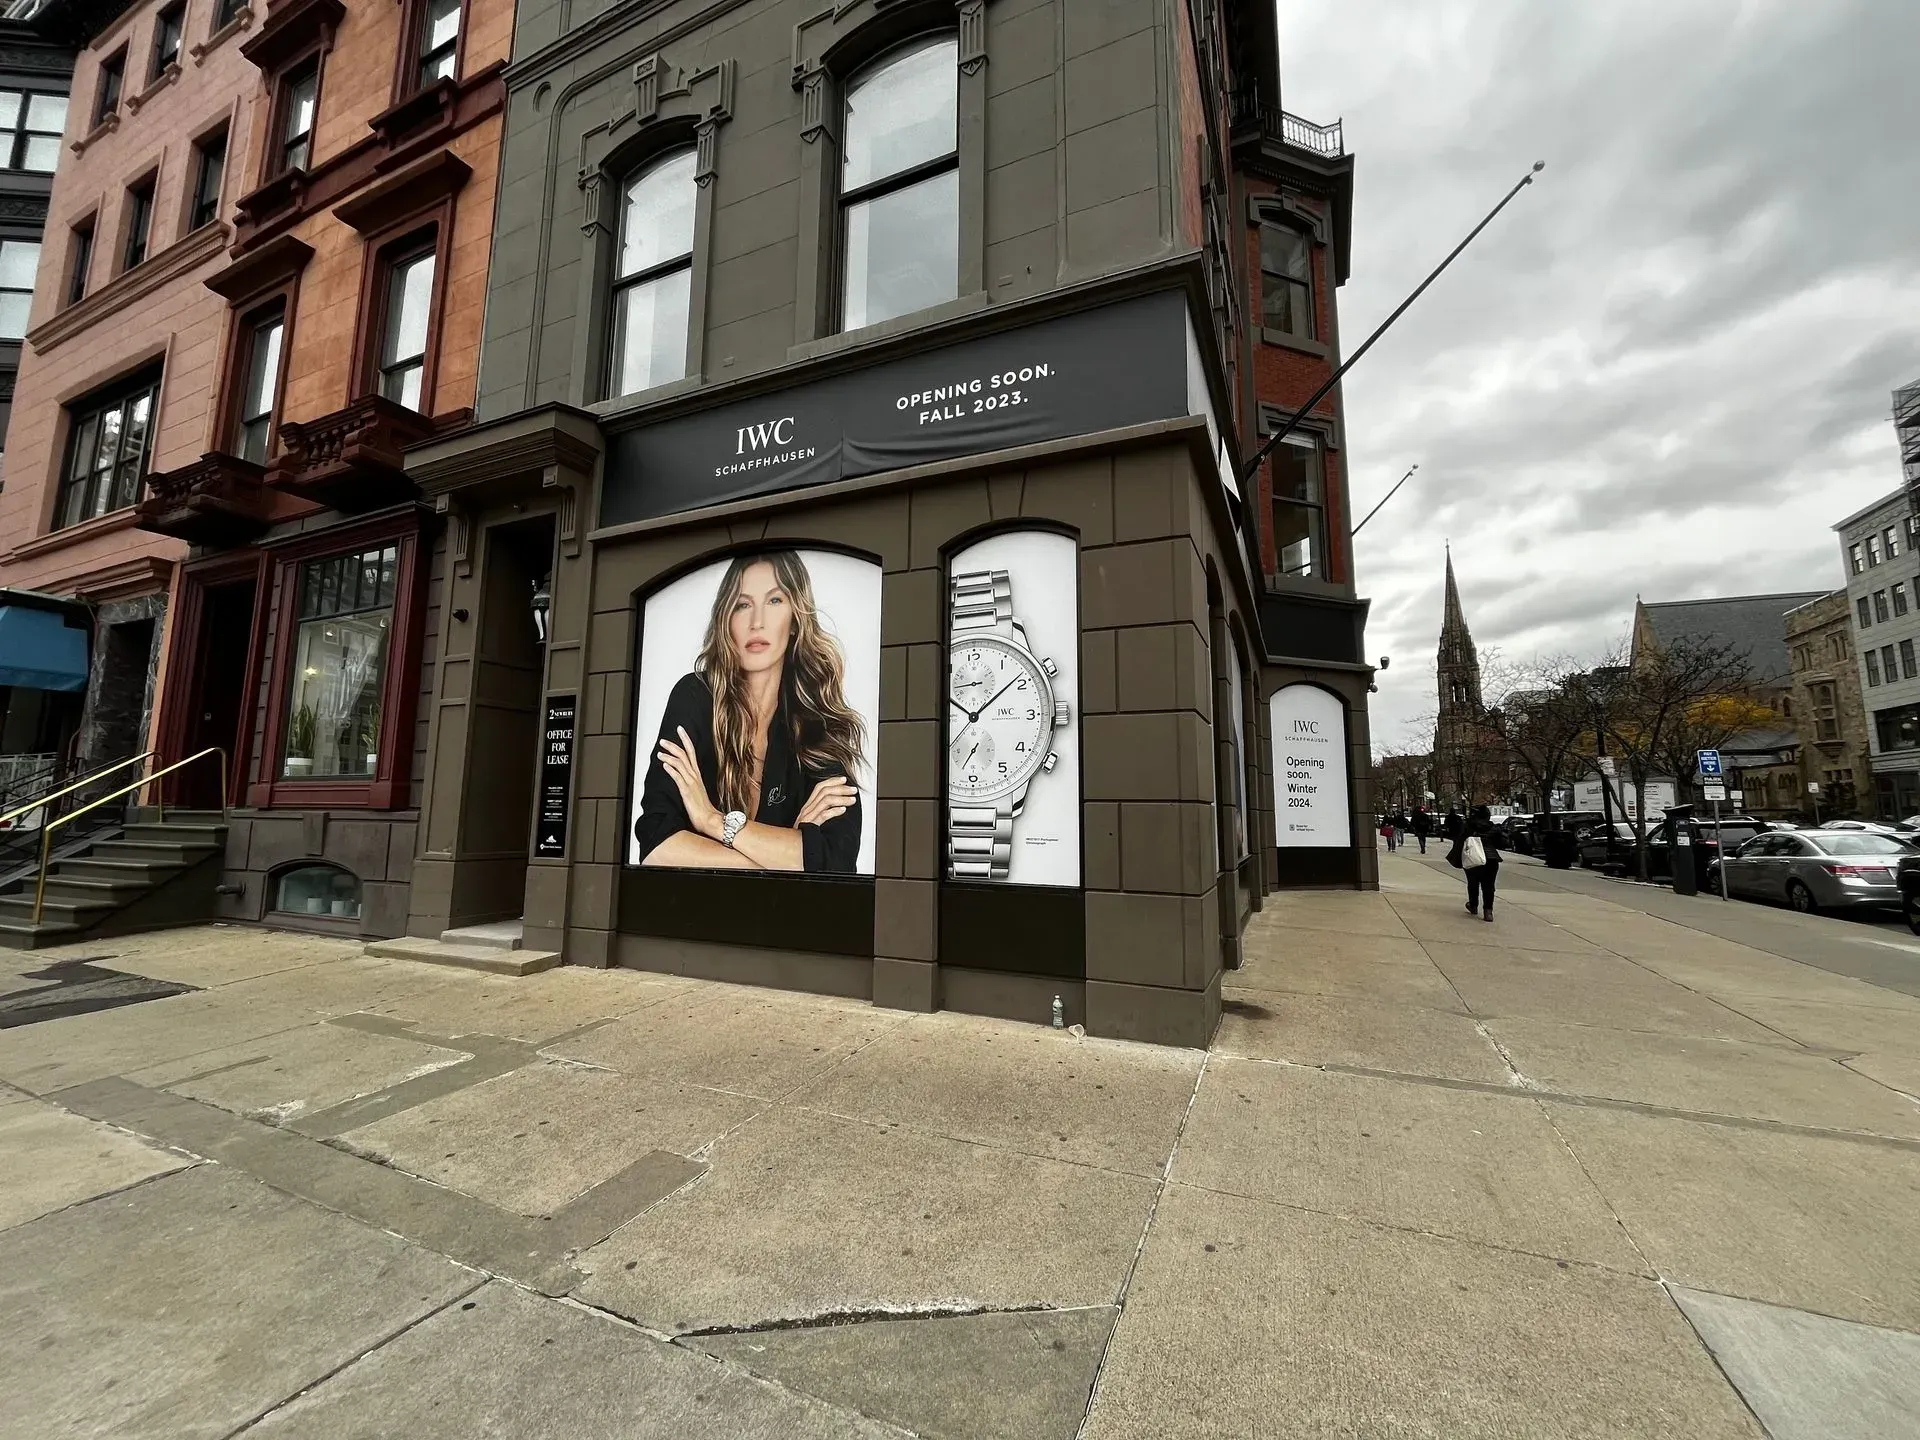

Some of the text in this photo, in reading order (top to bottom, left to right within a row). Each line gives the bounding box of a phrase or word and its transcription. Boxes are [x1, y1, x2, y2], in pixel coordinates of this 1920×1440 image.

[896, 363, 1056, 411] OPENING SOON.
[919, 390, 1030, 426] FALL 2023.
[735, 417, 796, 456] IWC
[714, 447, 816, 477] SCHAFFHAUSEN
[1017, 679, 1027, 690] 2
[998, 708, 1014, 717] IWC
[1026, 709, 1036, 720] 3
[1293, 720, 1319, 734] IWC
[547, 729, 573, 739] OFFICE
[551, 742, 566, 752] FOR
[1015, 741, 1025, 752] 4
[547, 755, 569, 765] LEASE
[1286, 756, 1325, 769] Opening
[998, 762, 1008, 773] 5
[1287, 771, 1312, 779] soon.
[1287, 783, 1317, 793] Winter
[1288, 798, 1313, 808] 2024.
